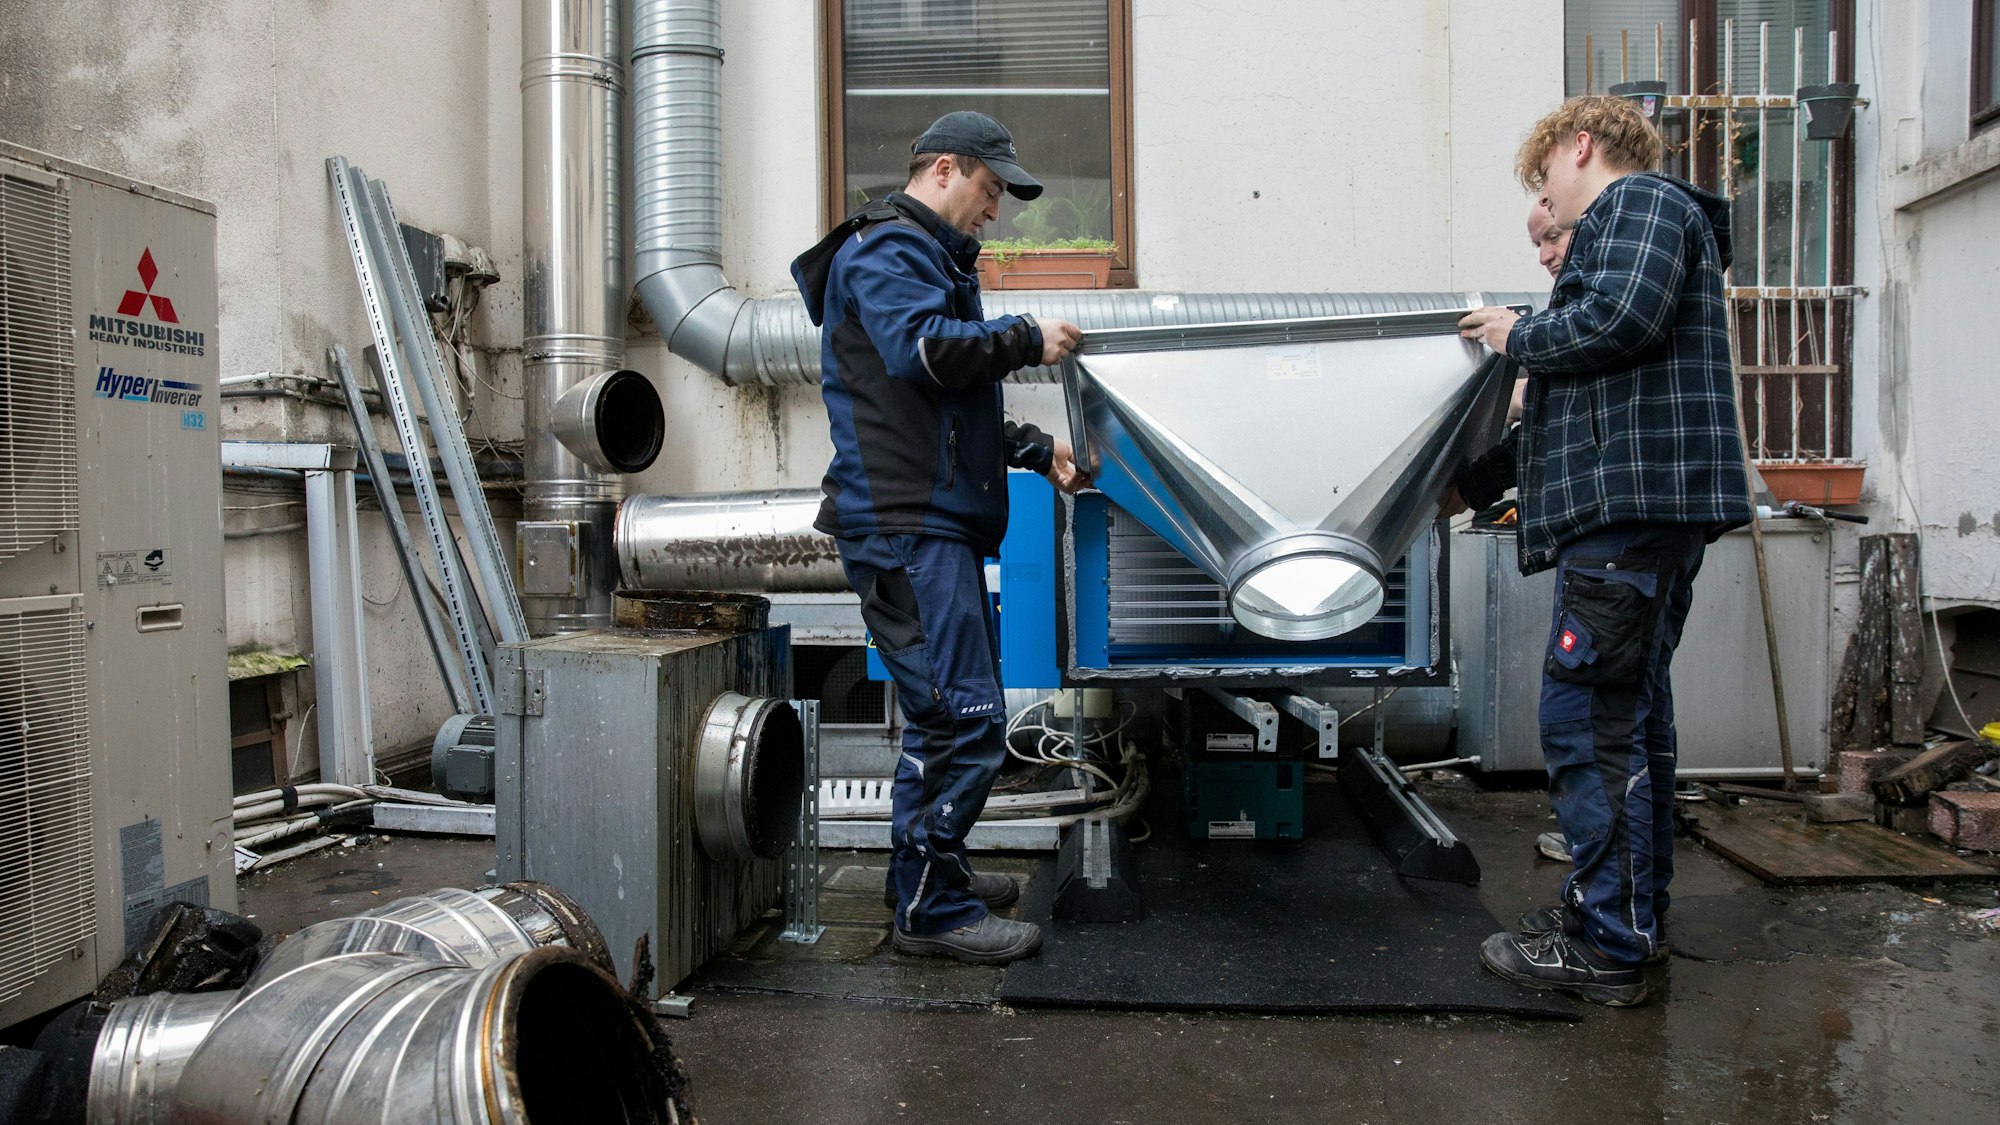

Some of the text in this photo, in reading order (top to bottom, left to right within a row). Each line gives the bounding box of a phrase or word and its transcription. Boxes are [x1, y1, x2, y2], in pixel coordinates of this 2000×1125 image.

[89, 314, 204, 346] MITSUBISHI
[89, 331, 204, 357] HEAVY INDUSTRIES
[95, 366, 202, 407] Hyper Inverter
[183, 413, 204, 428] H32
